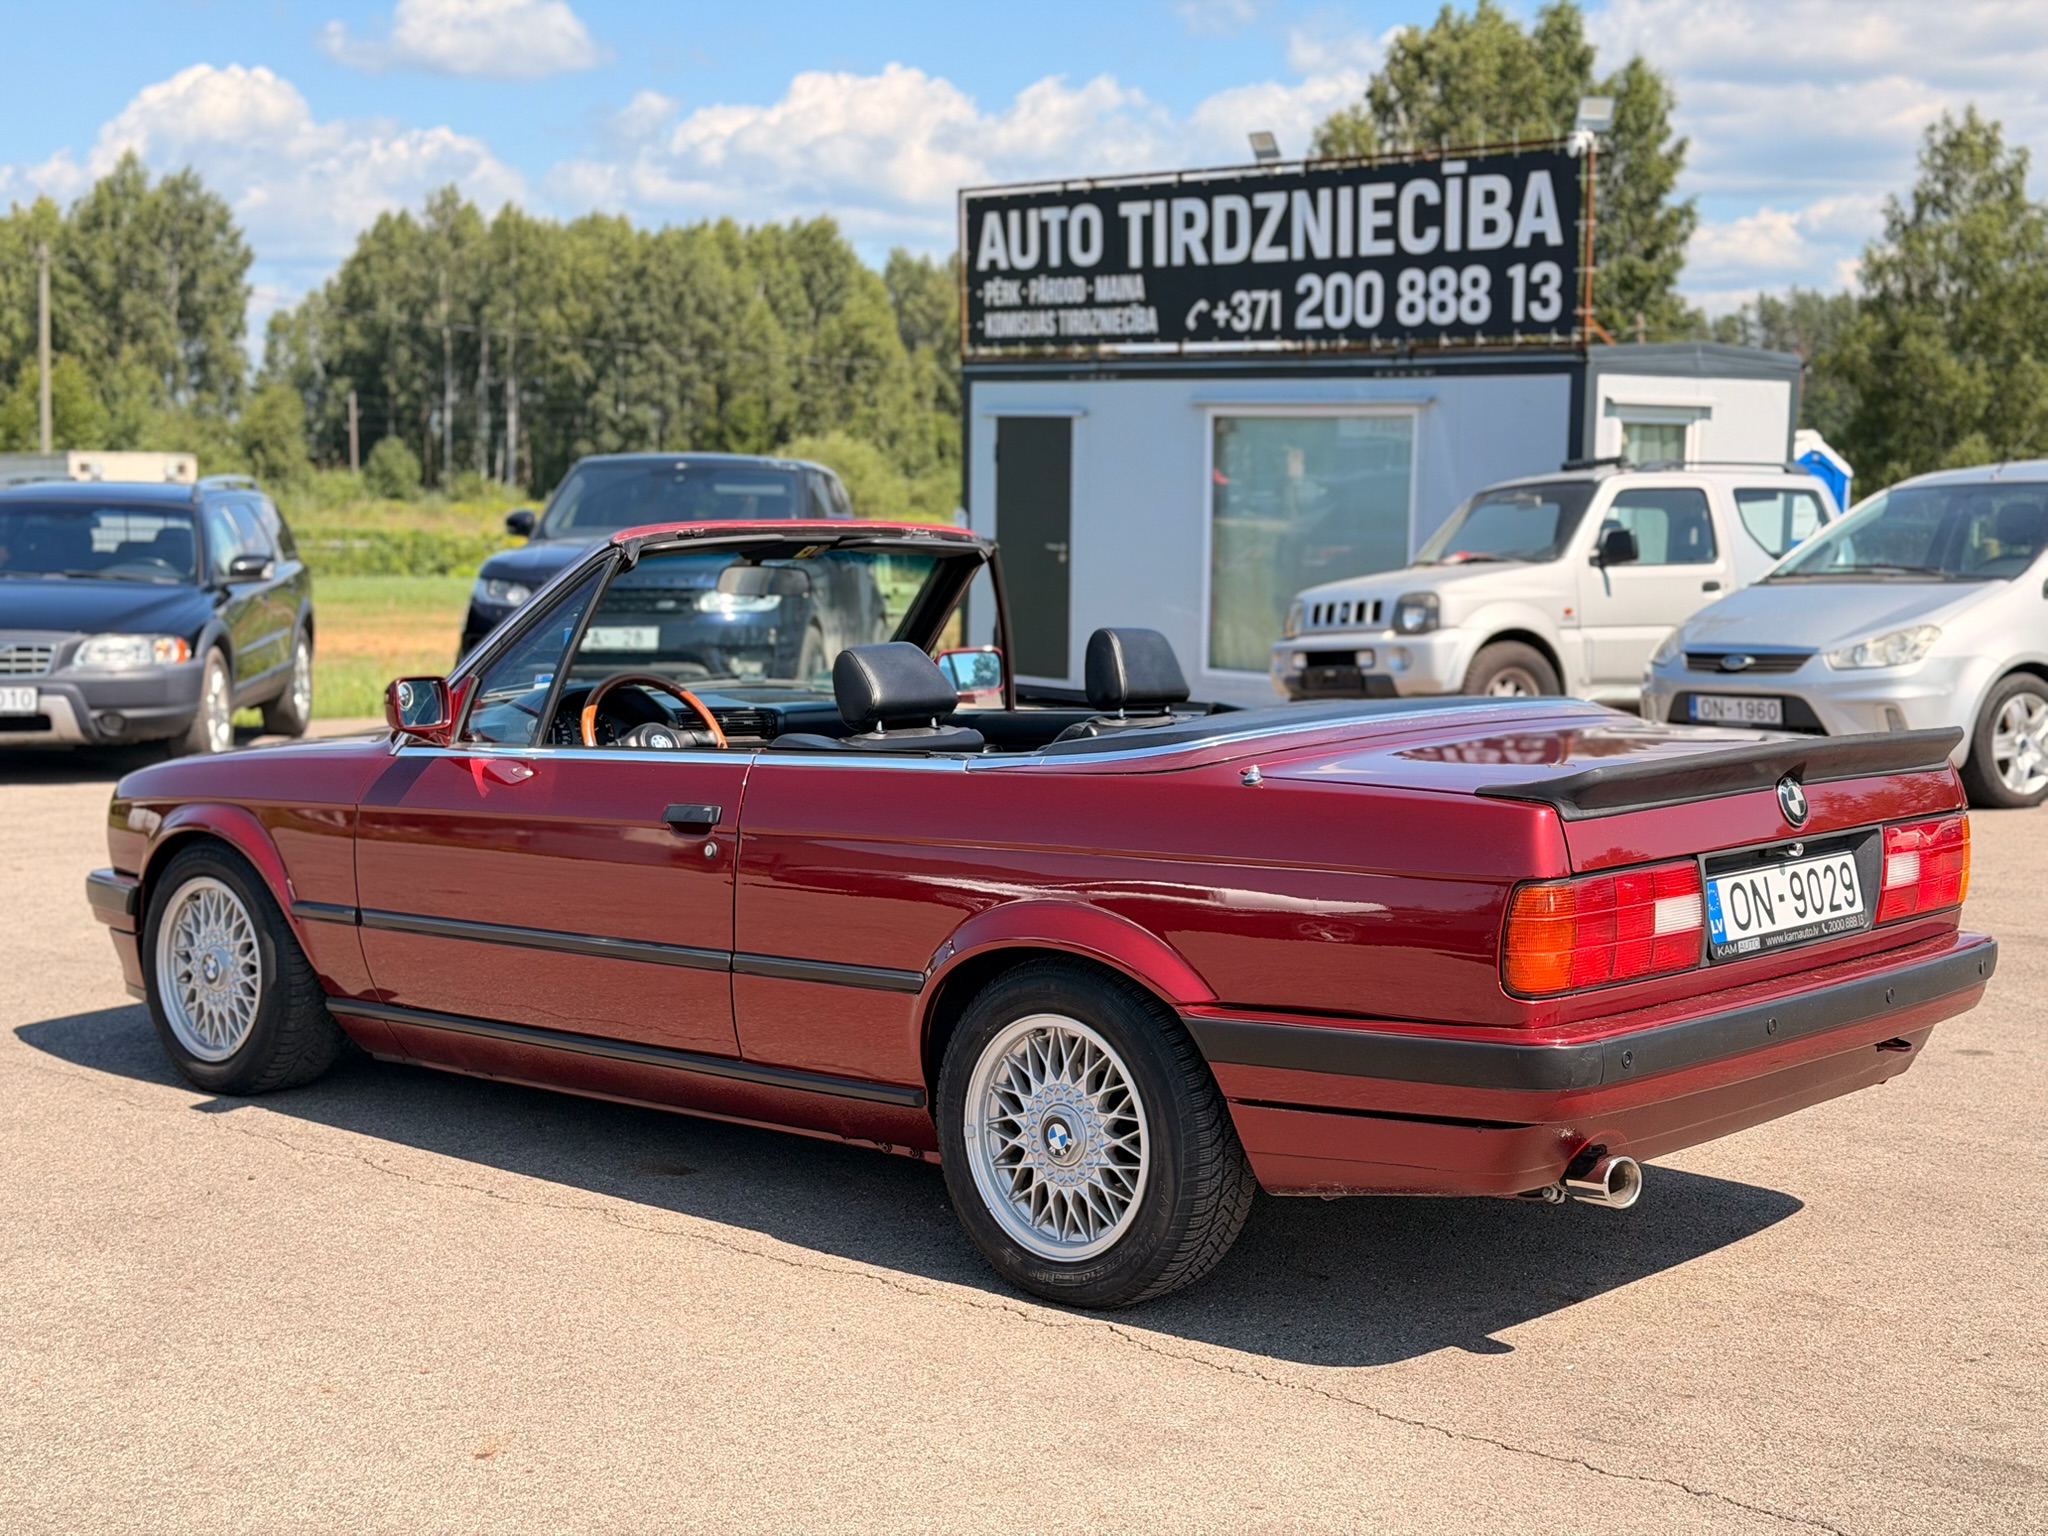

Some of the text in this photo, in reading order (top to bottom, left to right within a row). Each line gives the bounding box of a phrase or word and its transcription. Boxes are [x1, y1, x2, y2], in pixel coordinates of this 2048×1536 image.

[976, 162, 1564, 271] AUTO TIRDZNIECĪBA
[1212, 262, 1563, 332] +371 200 888 13
[1701, 699, 1778, 720] ON-1960
[1730, 861, 1856, 931] ON-9029
[1711, 918, 1724, 934] LV
[1766, 926, 1819, 946] www.kamauto.lv
